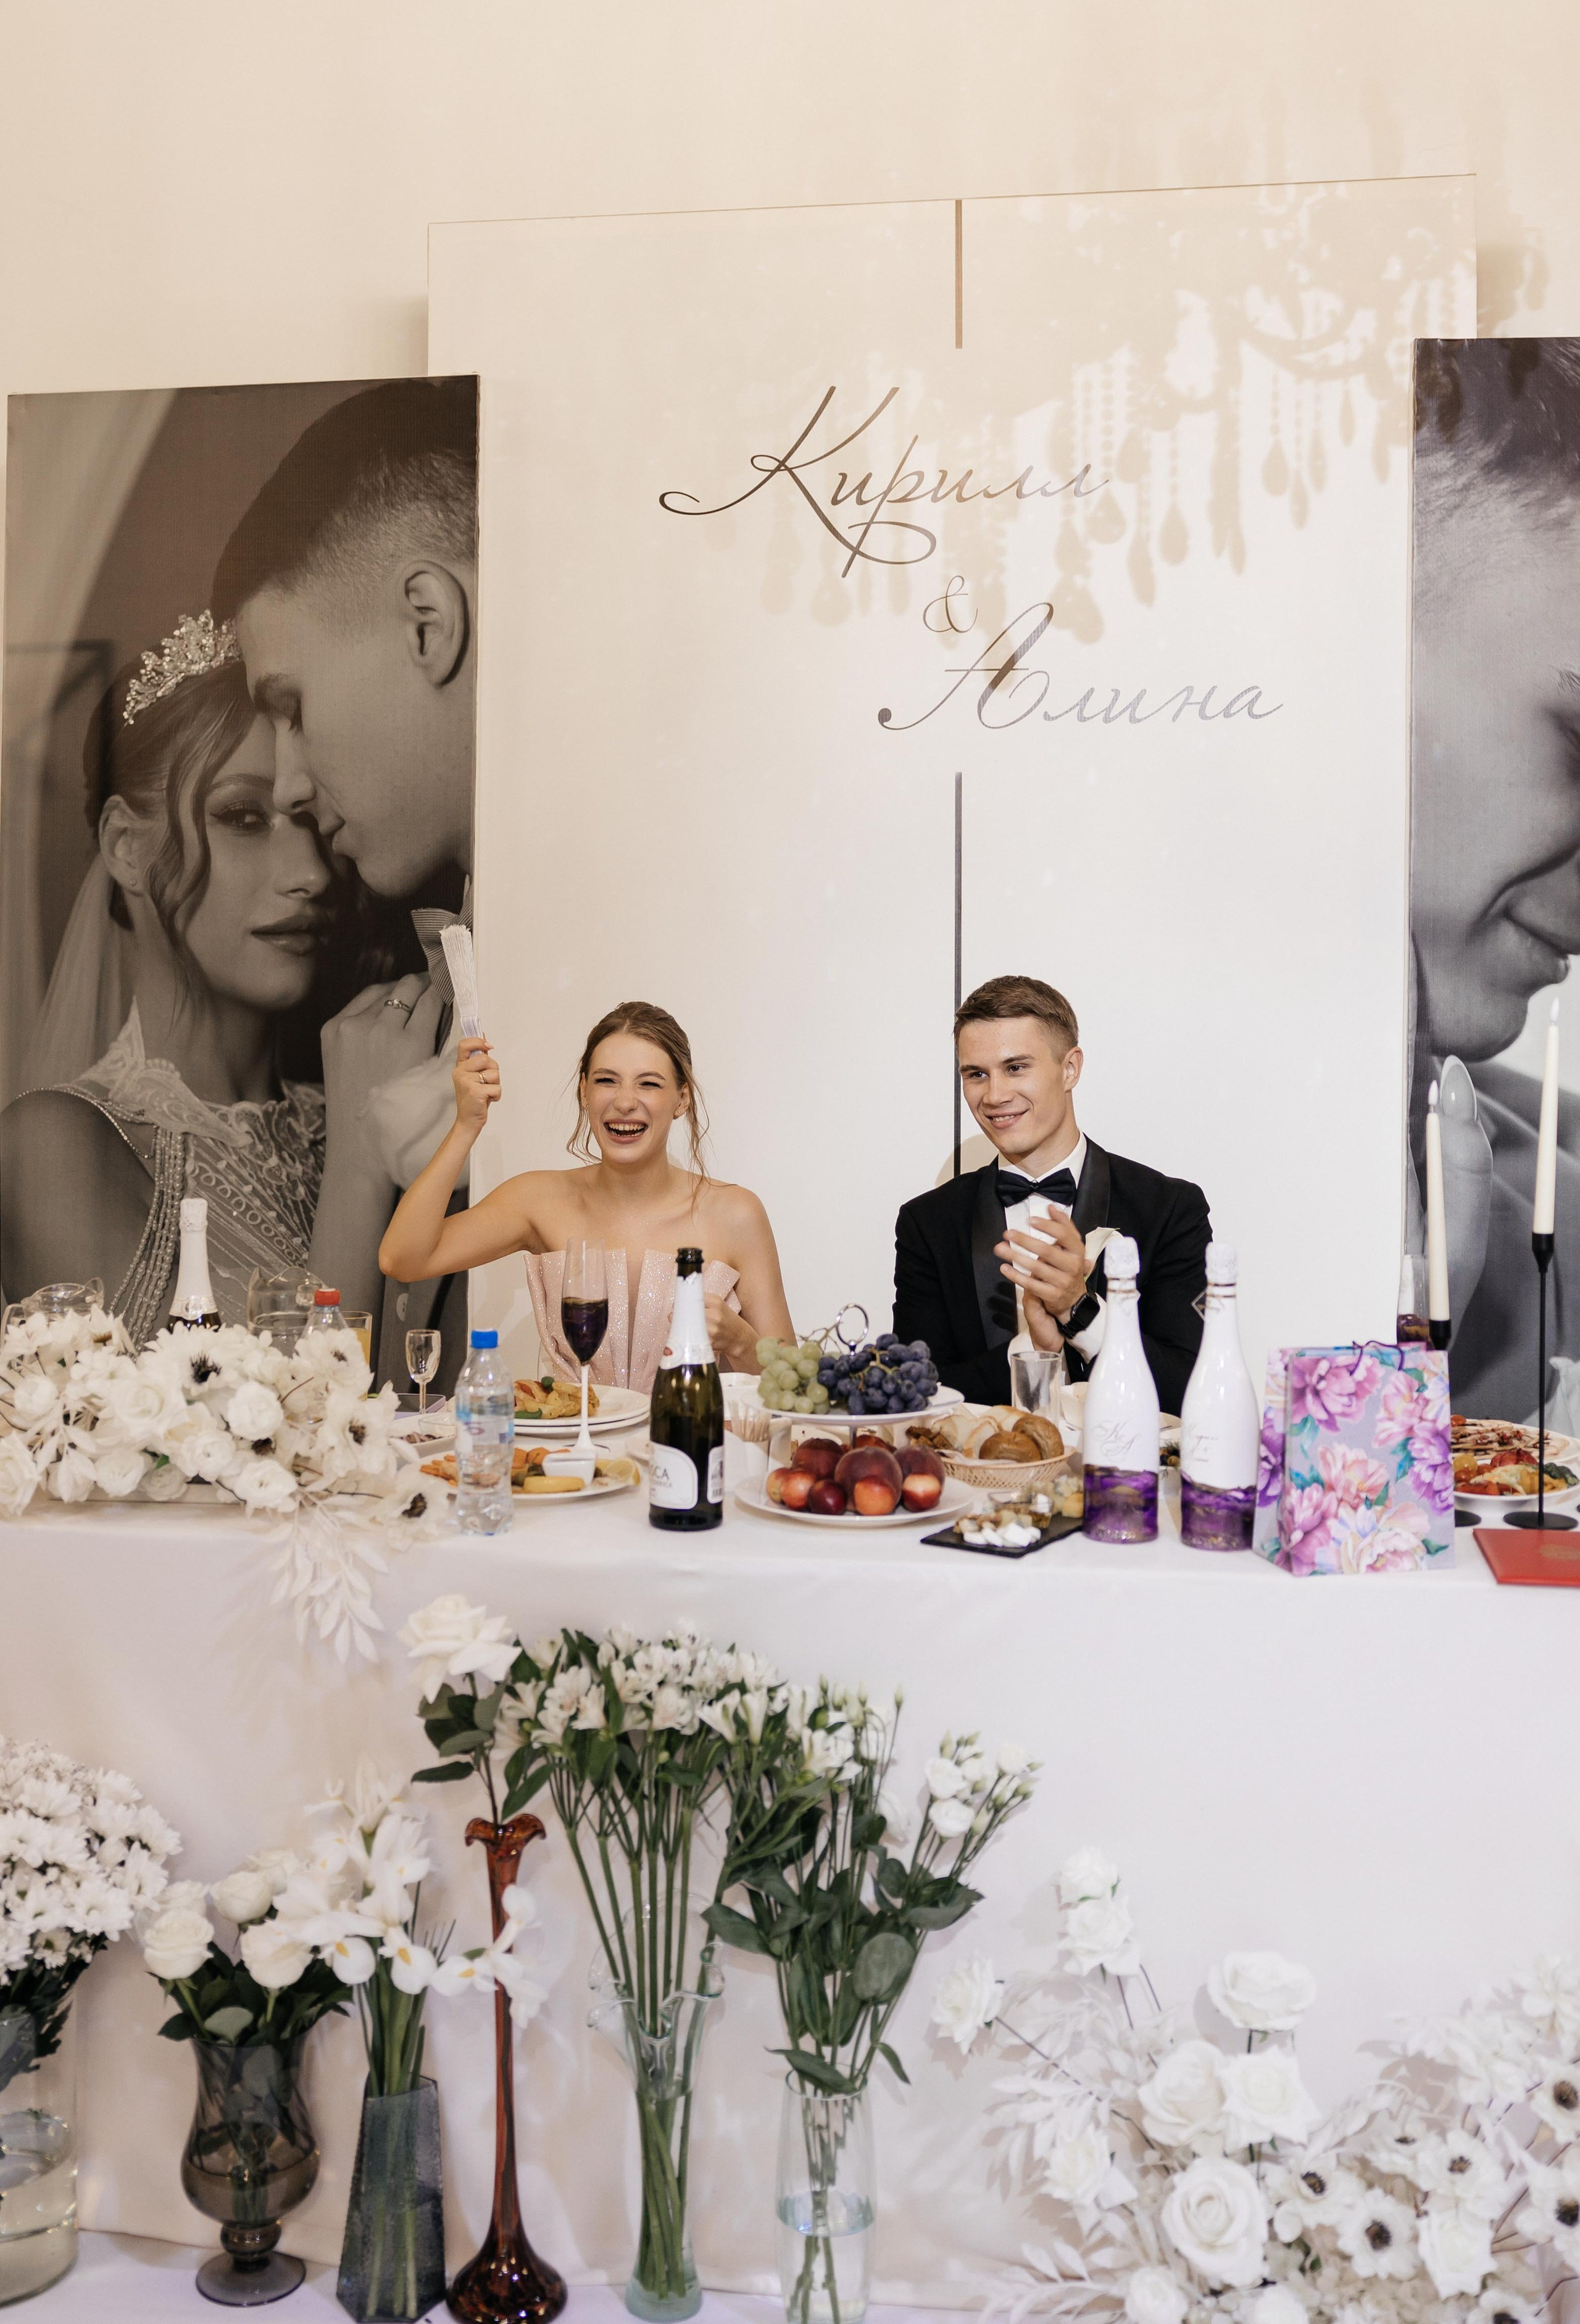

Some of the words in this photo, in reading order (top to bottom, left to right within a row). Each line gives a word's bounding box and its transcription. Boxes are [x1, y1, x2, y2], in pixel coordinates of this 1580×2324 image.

[659, 386, 1109, 579] Кирилл
[878, 602, 1283, 730] Алина
[923, 575, 978, 633] &
